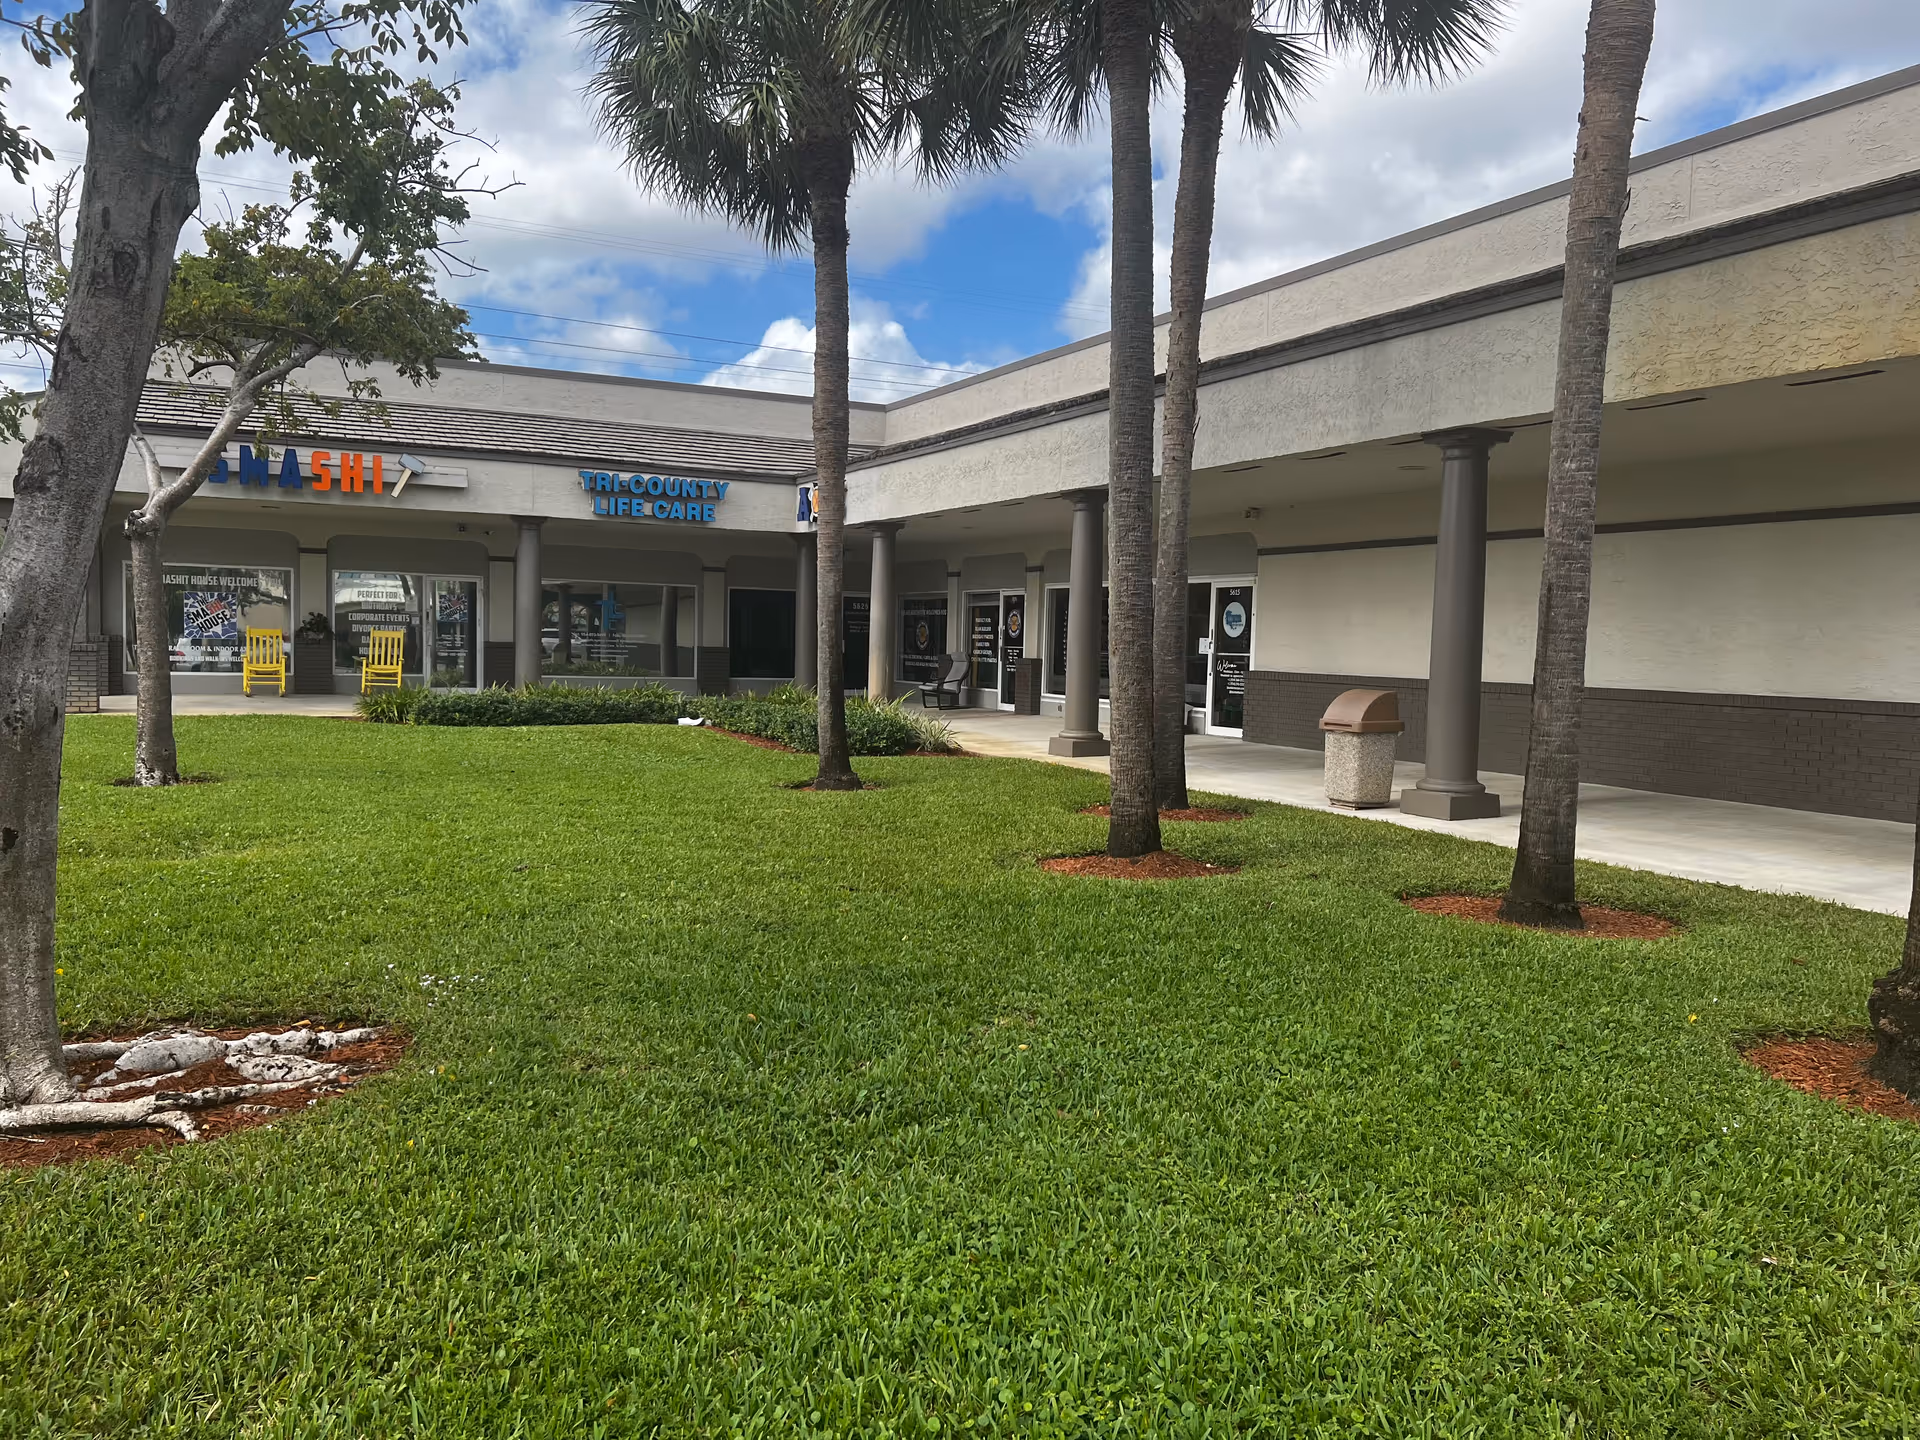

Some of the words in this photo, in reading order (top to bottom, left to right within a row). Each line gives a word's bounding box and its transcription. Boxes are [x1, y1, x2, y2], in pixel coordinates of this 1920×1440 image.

[579, 470, 730, 500] TRI-COUNTY
[594, 496, 645, 517] LIFE
[653, 500, 716, 522] CARE
[191, 575, 218, 586] HOUSE
[357, 590, 384, 599] PERFECT
[197, 610, 230, 633] HOUSE
[348, 612, 386, 622] CORPORATE
[386, 613, 410, 622] EVENTS
[352, 624, 379, 633] DIVORE
